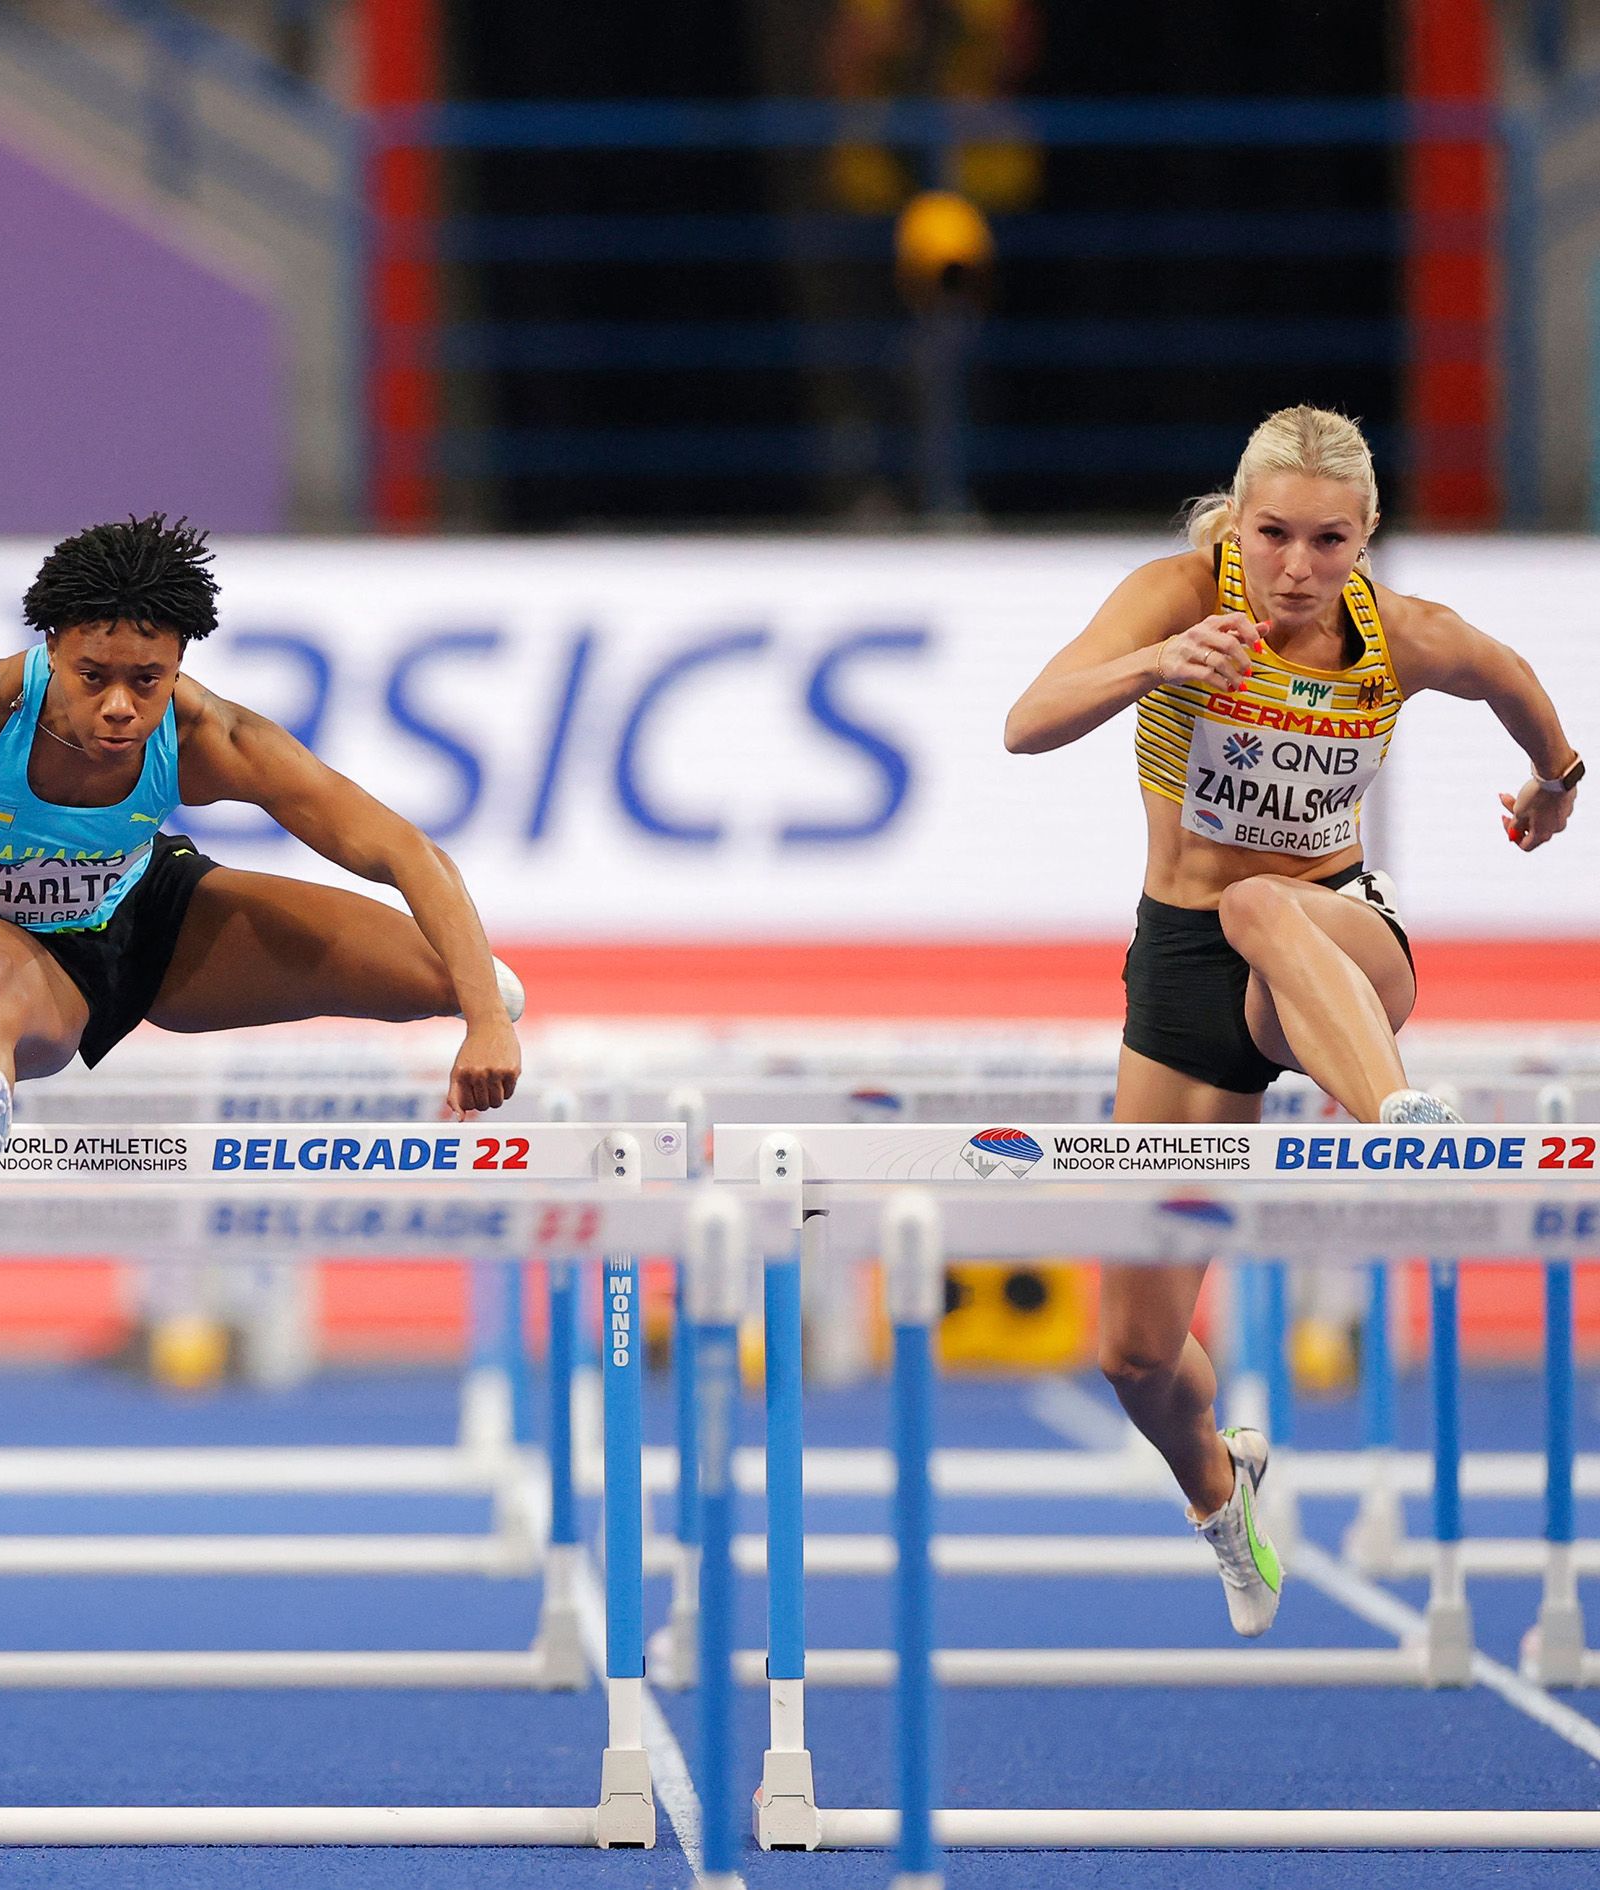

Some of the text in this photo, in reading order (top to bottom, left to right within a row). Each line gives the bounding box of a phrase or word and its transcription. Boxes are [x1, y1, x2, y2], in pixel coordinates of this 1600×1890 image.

[1206, 693, 1380, 739] GERMANY
[1272, 741, 1360, 776] QNB
[1195, 767, 1357, 823] ZAPALSKA
[1235, 820, 1351, 850] BELGRADE 22
[73, 1138, 187, 1154] ATHLETICS
[212, 1137, 531, 1171] BELGRADE 22
[1053, 1137, 1250, 1154] WORLD ATHLETICS
[1275, 1136, 1597, 1170] BELGRADE 22
[56, 1158, 187, 1171] CHAMPIONSHIPS
[1053, 1157, 1250, 1170] INDOOR CHAMPIONSHIPS
[609, 1276, 632, 1367] MONDO
